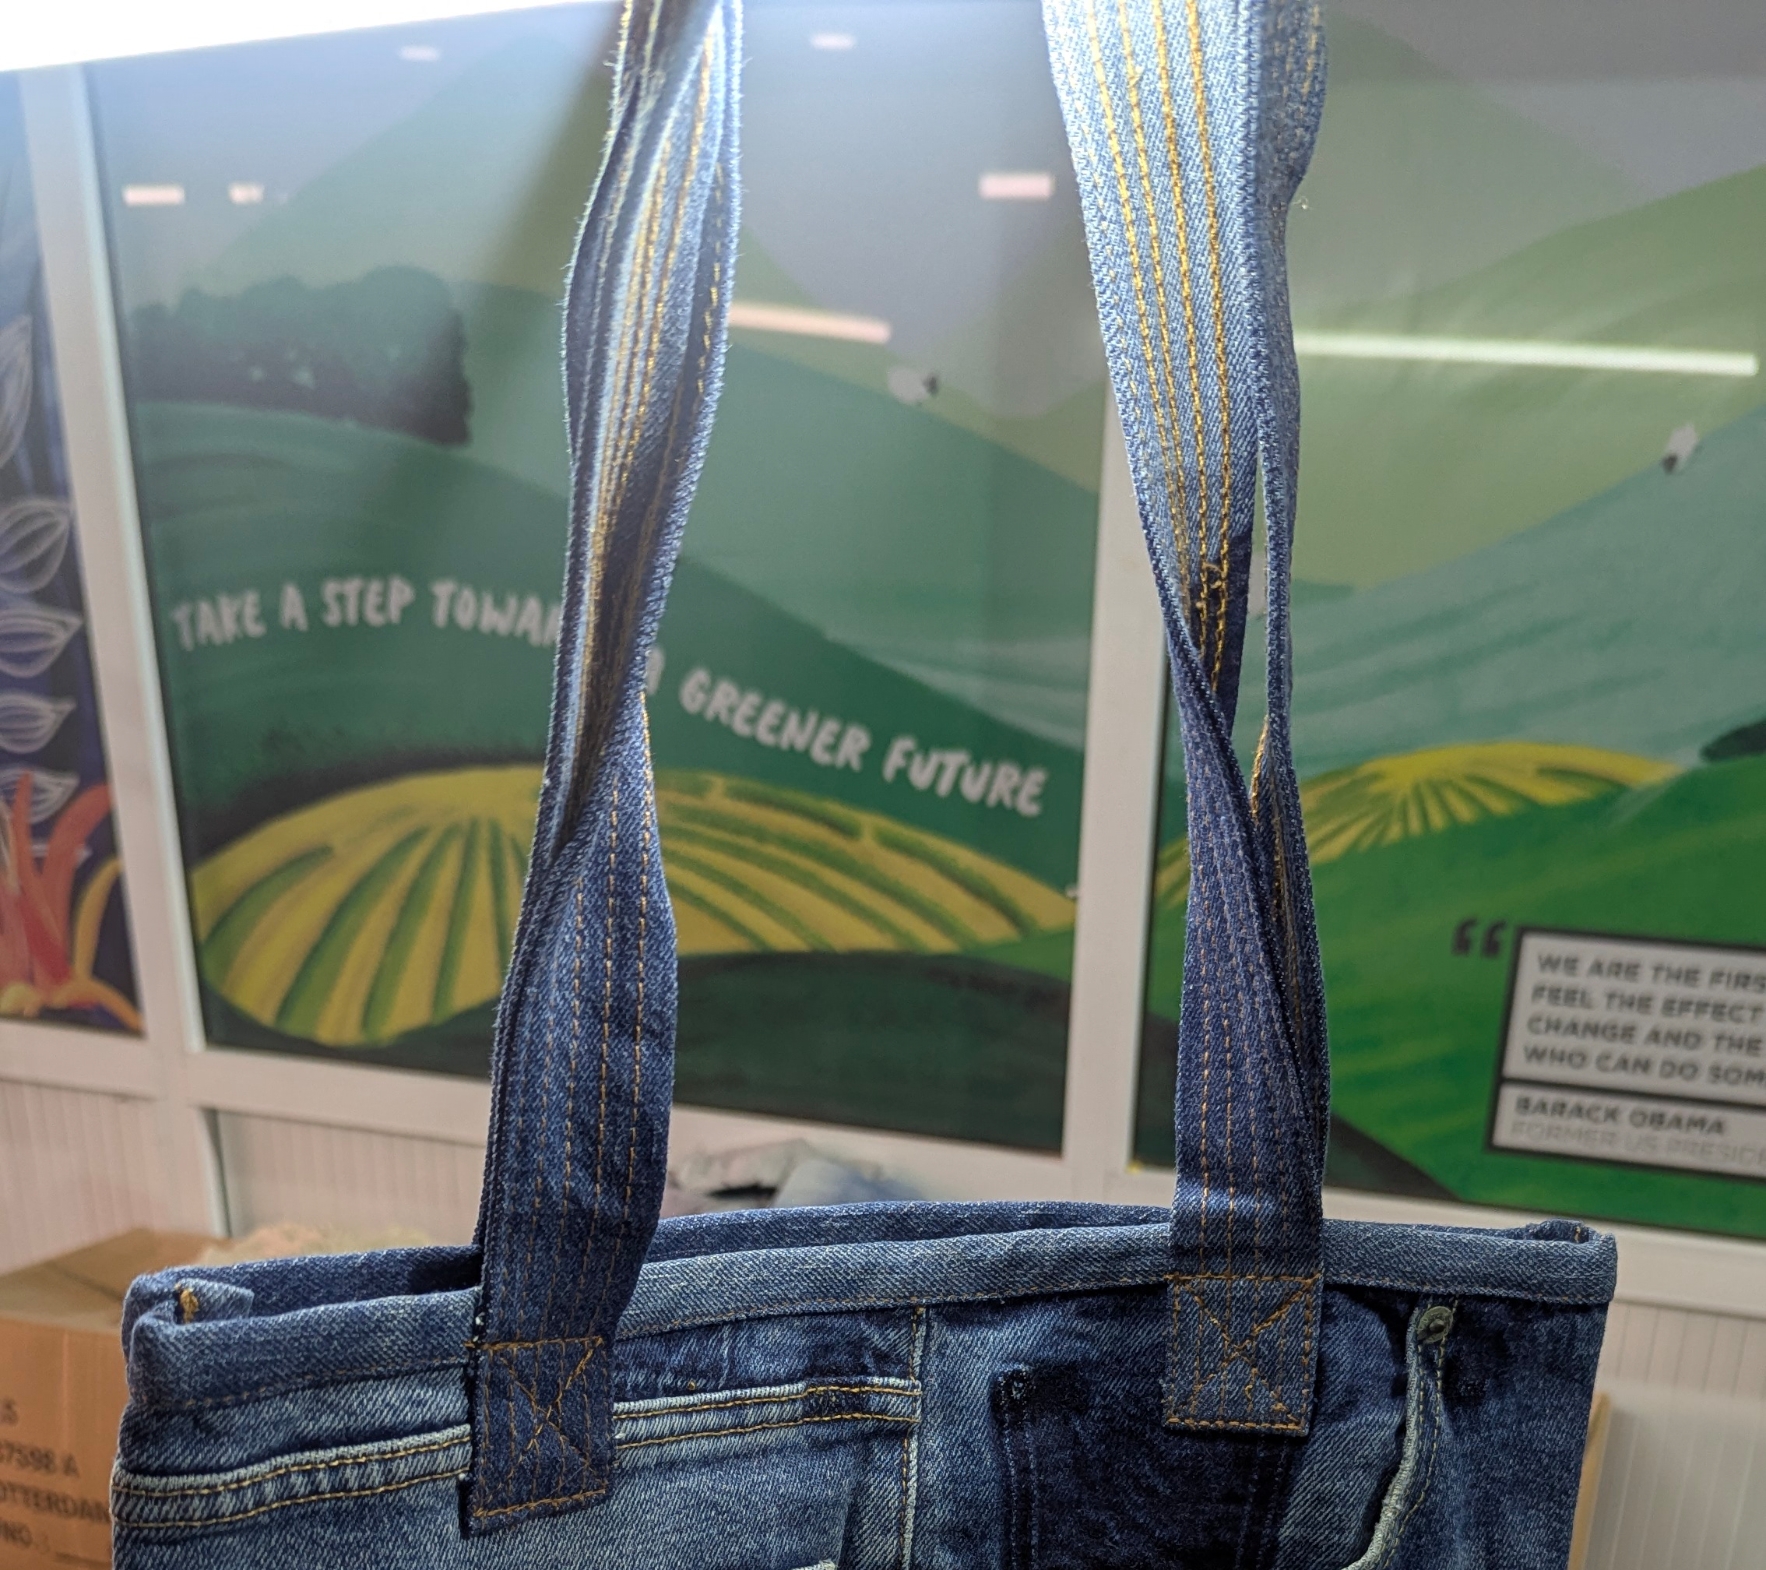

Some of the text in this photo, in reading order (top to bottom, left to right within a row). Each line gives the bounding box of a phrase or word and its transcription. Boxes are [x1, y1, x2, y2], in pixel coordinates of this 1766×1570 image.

[171, 589, 267, 650] TAKE
[279, 581, 309, 631] A
[321, 573, 415, 628] STEP
[679, 667, 870, 772] GREENER
[882, 735, 1048, 817] FUTURE
[1537, 954, 1579, 977] WE
[1587, 960, 1641, 983] ARE
[1651, 963, 1700, 988] THE
[1531, 983, 1592, 1009] FEEL
[1603, 990, 1653, 1015] THE
[1526, 1015, 1762, 1058] CHANGE AND THE
[1523, 1045, 1588, 1070] WHO
[1595, 1051, 1649, 1076] CAN
[1658, 1058, 1699, 1081] DO
[1514, 1096, 1725, 1135] BARACK OBAMA
